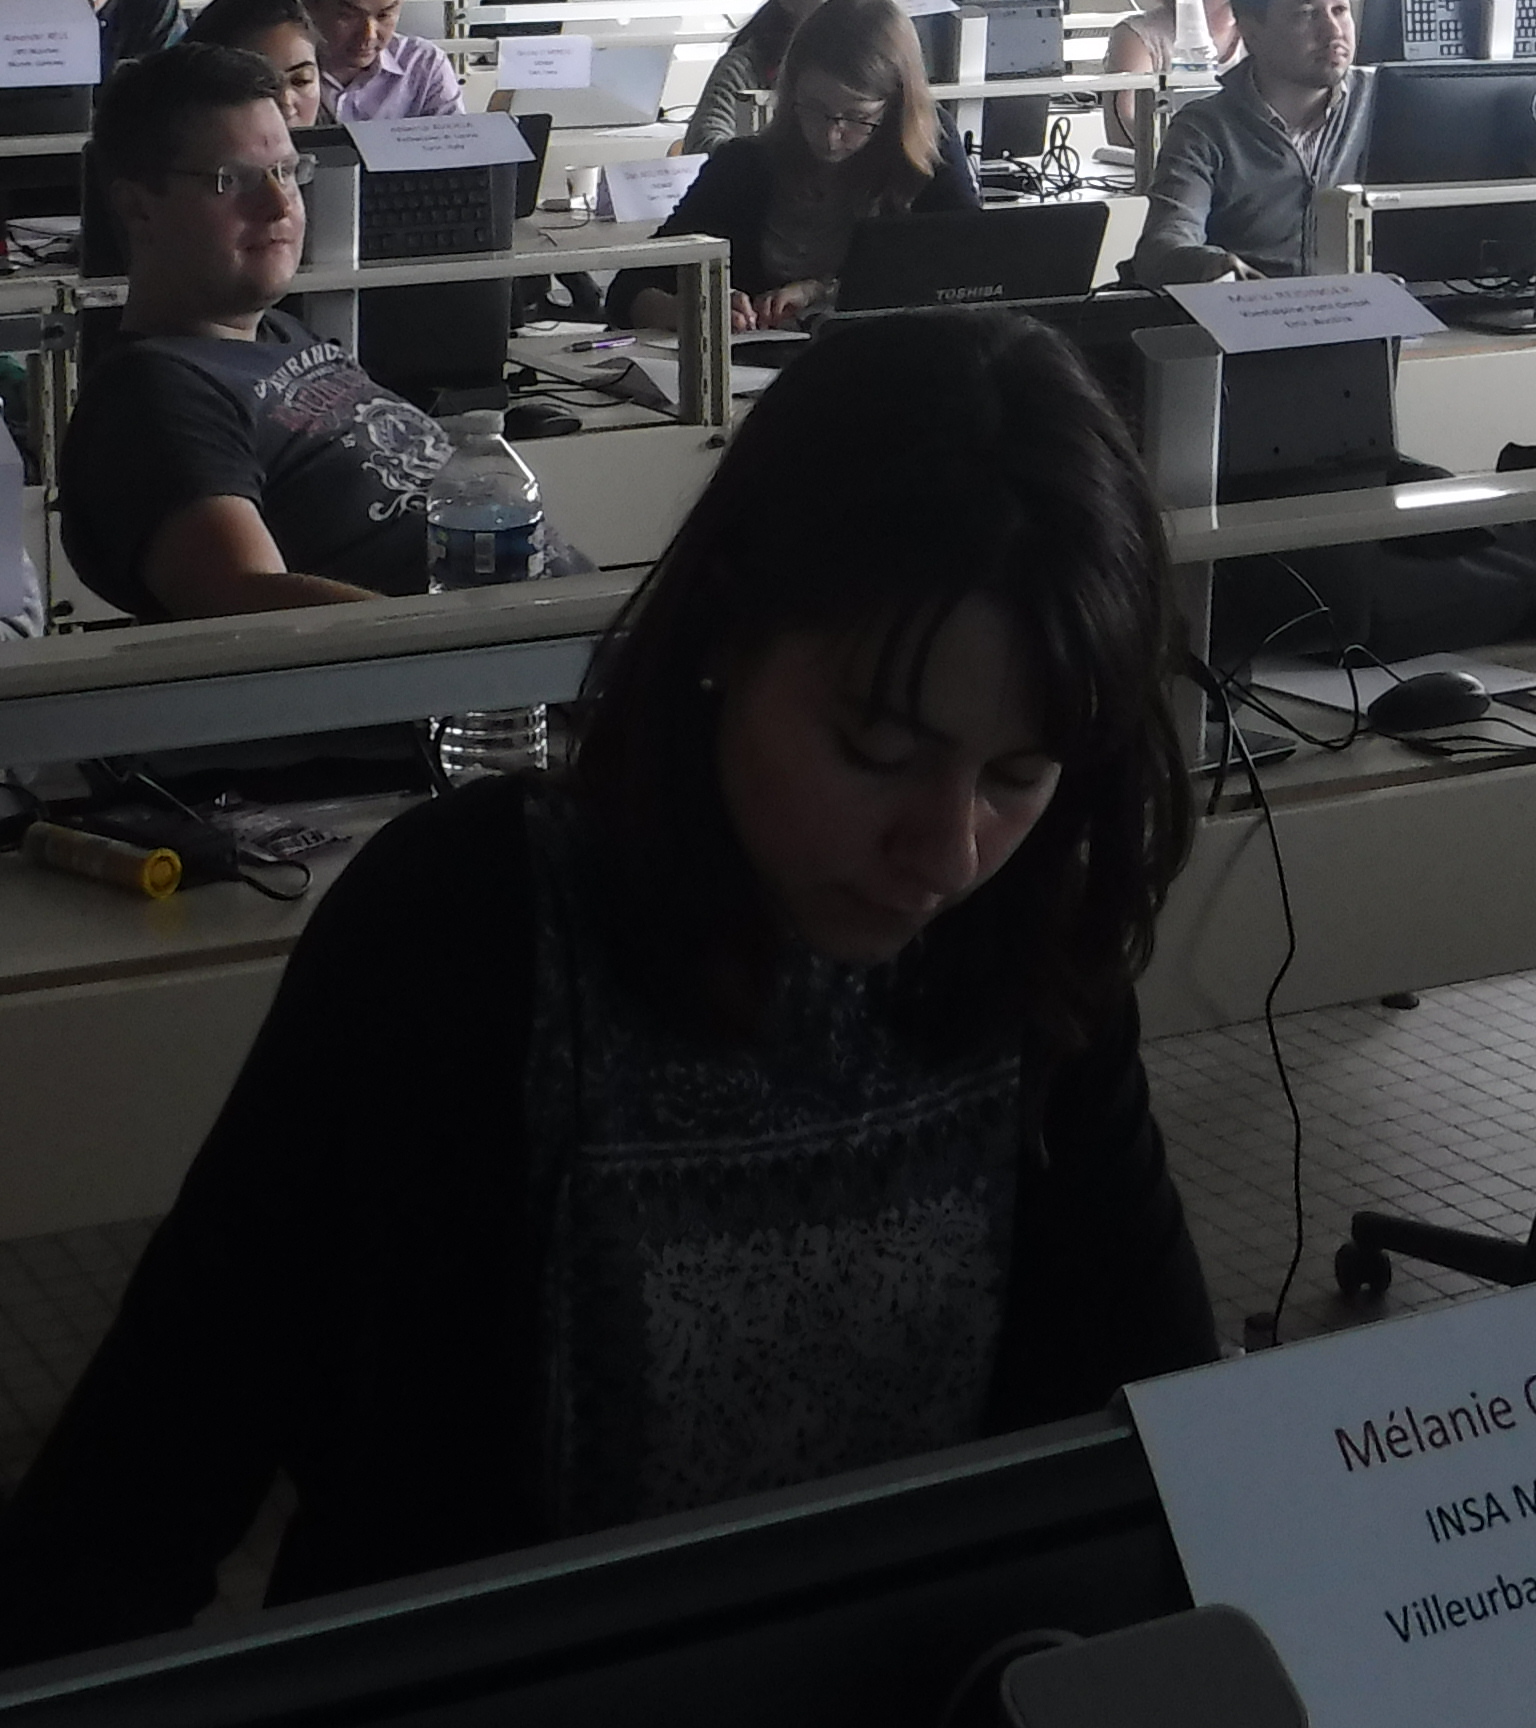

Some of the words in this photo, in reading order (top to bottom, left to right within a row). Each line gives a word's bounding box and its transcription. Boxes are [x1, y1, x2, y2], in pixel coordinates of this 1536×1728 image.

[936, 283, 1005, 301] TOSHIBA
[1334, 1391, 1517, 1473] Mélanie
[1425, 1491, 1512, 1544] INSA
